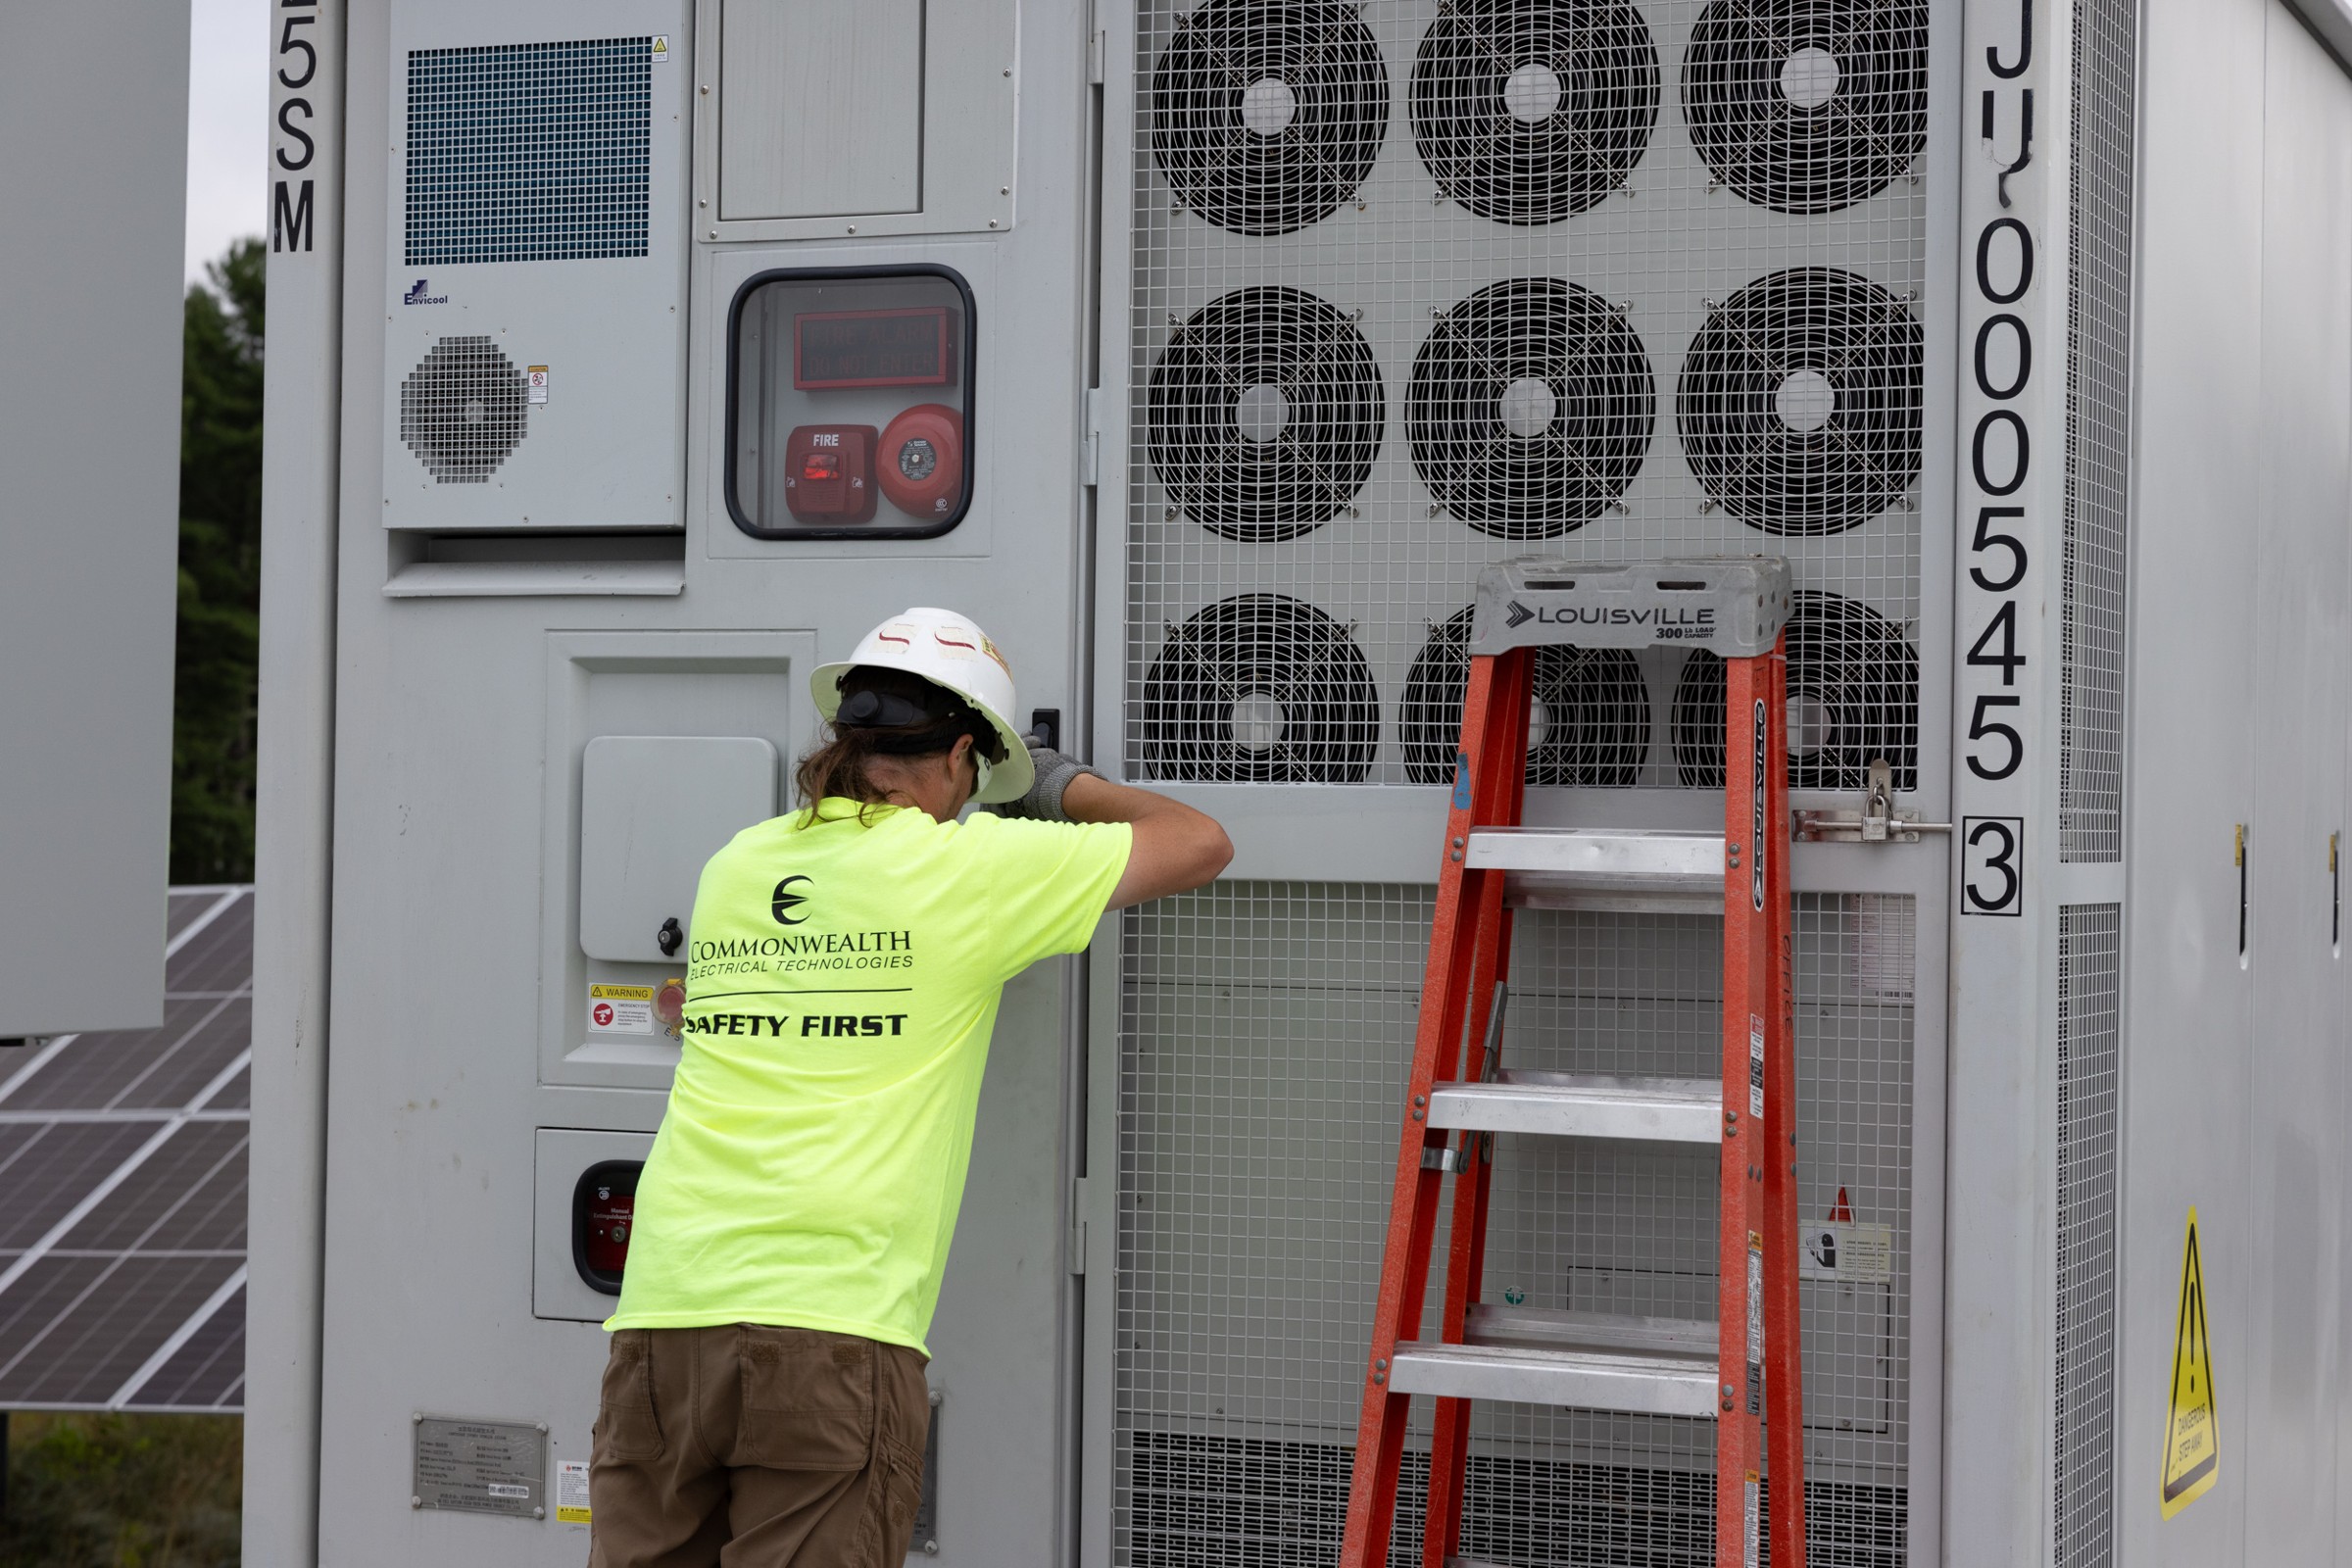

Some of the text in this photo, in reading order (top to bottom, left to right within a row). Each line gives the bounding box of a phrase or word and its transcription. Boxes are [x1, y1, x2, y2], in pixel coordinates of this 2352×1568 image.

[404, 293, 448, 305] Envicool
[813, 434, 839, 447] FIRE
[1538, 607, 1715, 625] LOUISVILLE
[1655, 627, 1683, 639] 300
[1755, 706, 1764, 872] LOUISVILLE
[691, 931, 913, 963] COMMONWEALTH
[690, 955, 913, 981] ELECTRICAL TECHNOLOGIES
[606, 988, 649, 999] WARNING
[1783, 934, 1793, 1036] OFFICE
[685, 1014, 908, 1037] SAFETY FIRST
[2178, 1402, 2206, 1437] DANGEROUS
[2179, 1438, 2191, 1462] STEP
